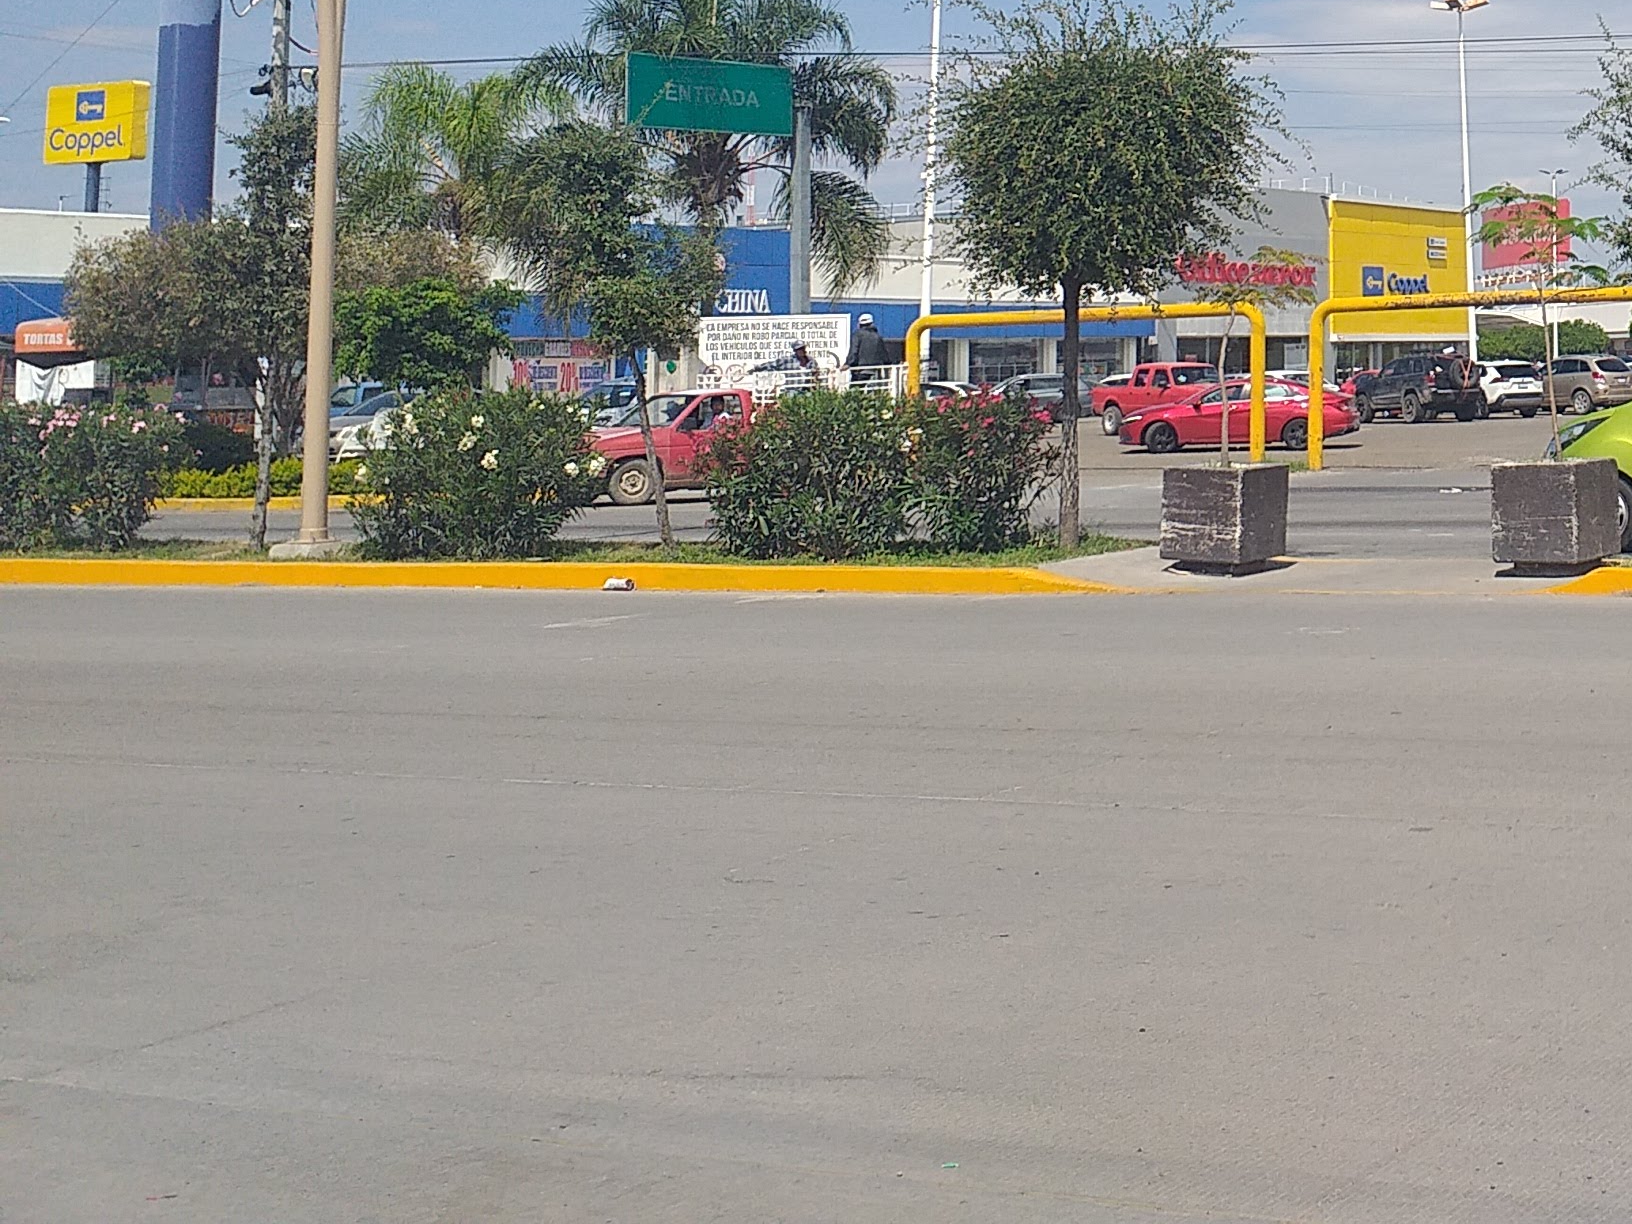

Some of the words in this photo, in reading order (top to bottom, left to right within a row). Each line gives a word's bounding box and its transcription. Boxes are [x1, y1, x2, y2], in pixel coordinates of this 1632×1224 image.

[665, 81, 760, 108] ENTRADA
[50, 124, 124, 157] Coppel
[1388, 272, 1430, 295] Coppel
[715, 289, 771, 313] CHINA
[717, 323, 749, 331] EMPRESA
[751, 323, 760, 331] NO
[762, 322, 770, 330] SE
[772, 322, 789, 330] HACE
[792, 321, 838, 329] RESPONSABLE
[23, 333, 64, 345] TORTAS
[707, 333, 720, 341] POR
[743, 332, 749, 340] NI
[752, 332, 769, 340] ROBO
[801, 331, 805, 339] O
[807, 331, 826, 339] TOTAL
[706, 343, 718, 351] LOS
[760, 342, 771, 350] QUE
[774, 341, 781, 349] SE
[830, 341, 838, 349] EN
[722, 352, 752, 360] INTERIOR
[754, 351, 766, 359] DEL
